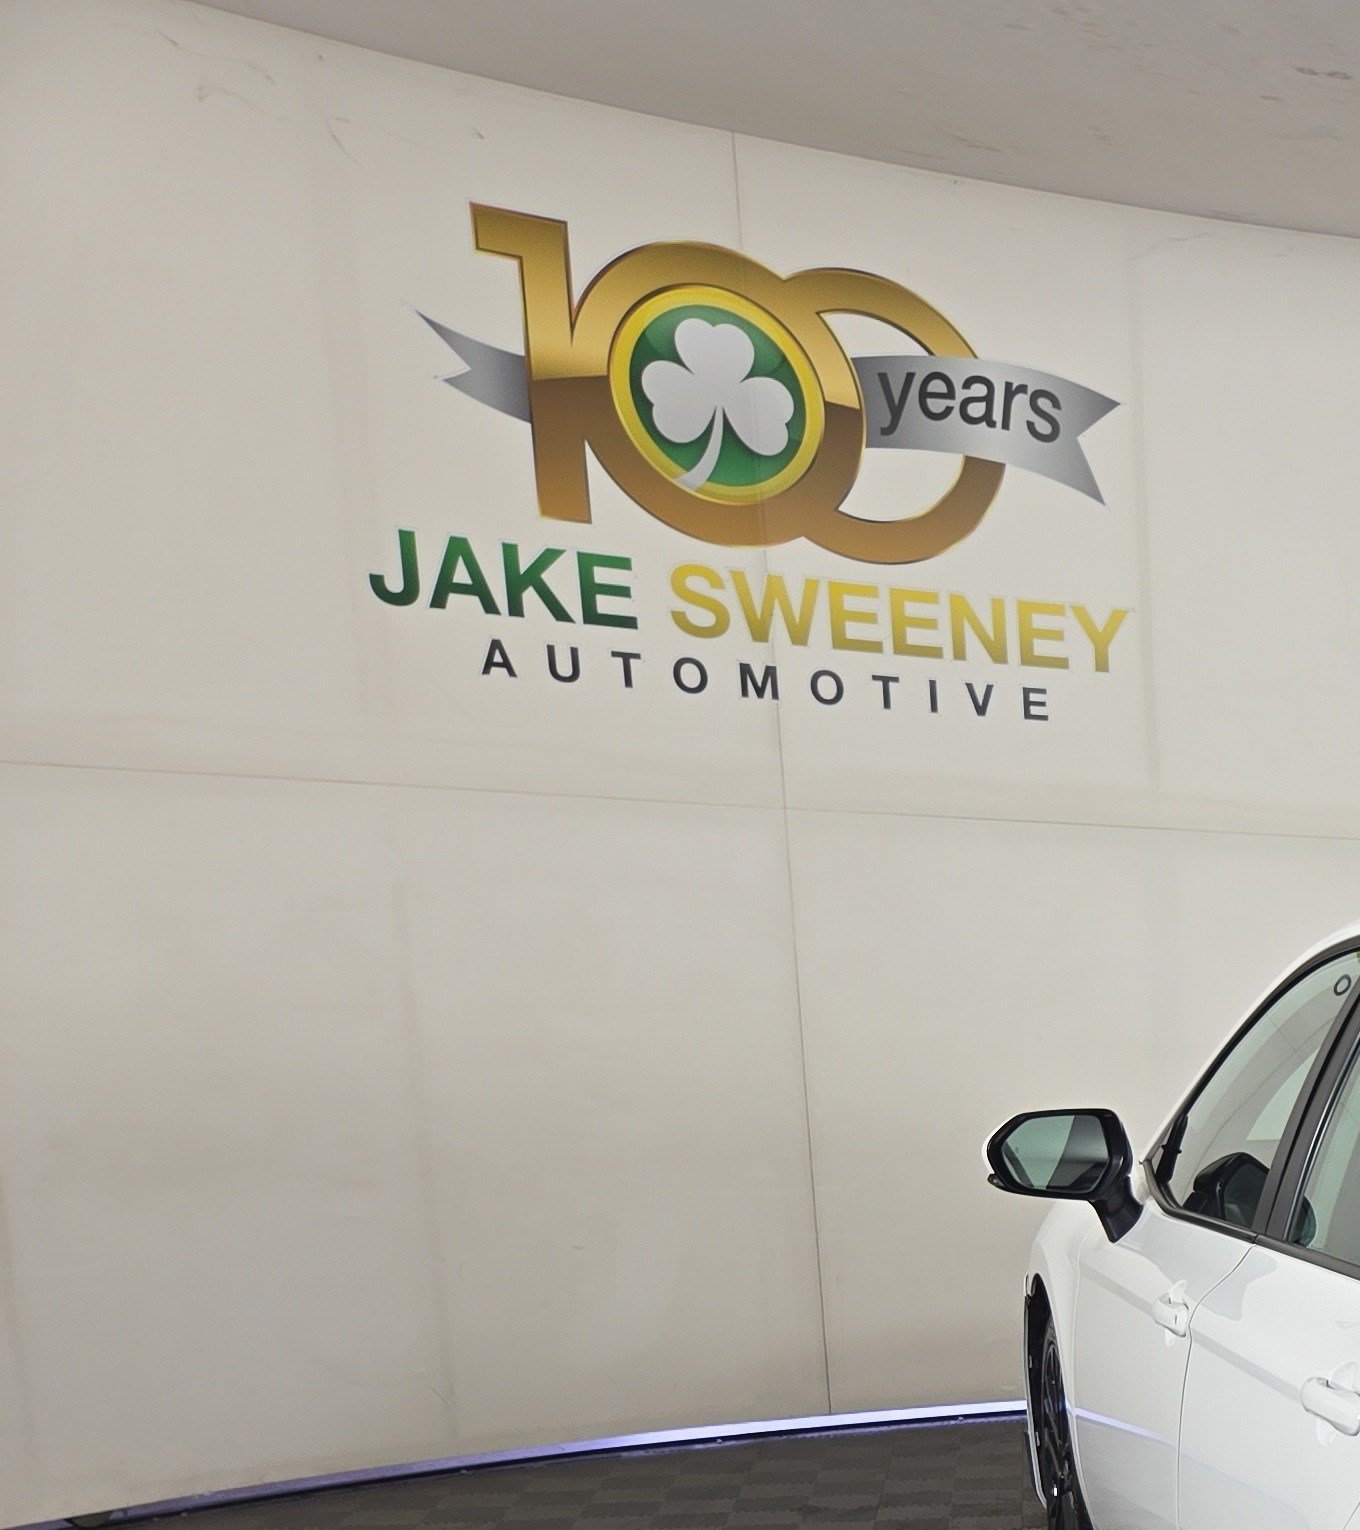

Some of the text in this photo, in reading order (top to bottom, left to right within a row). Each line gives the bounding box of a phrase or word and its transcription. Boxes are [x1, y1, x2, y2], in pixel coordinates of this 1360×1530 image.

[470, 202, 1006, 565] 100
[878, 369, 1062, 444] years
[369, 529, 1130, 673] JAKE SWEENEY
[481, 639, 1051, 722] AUTOMOTIVE
